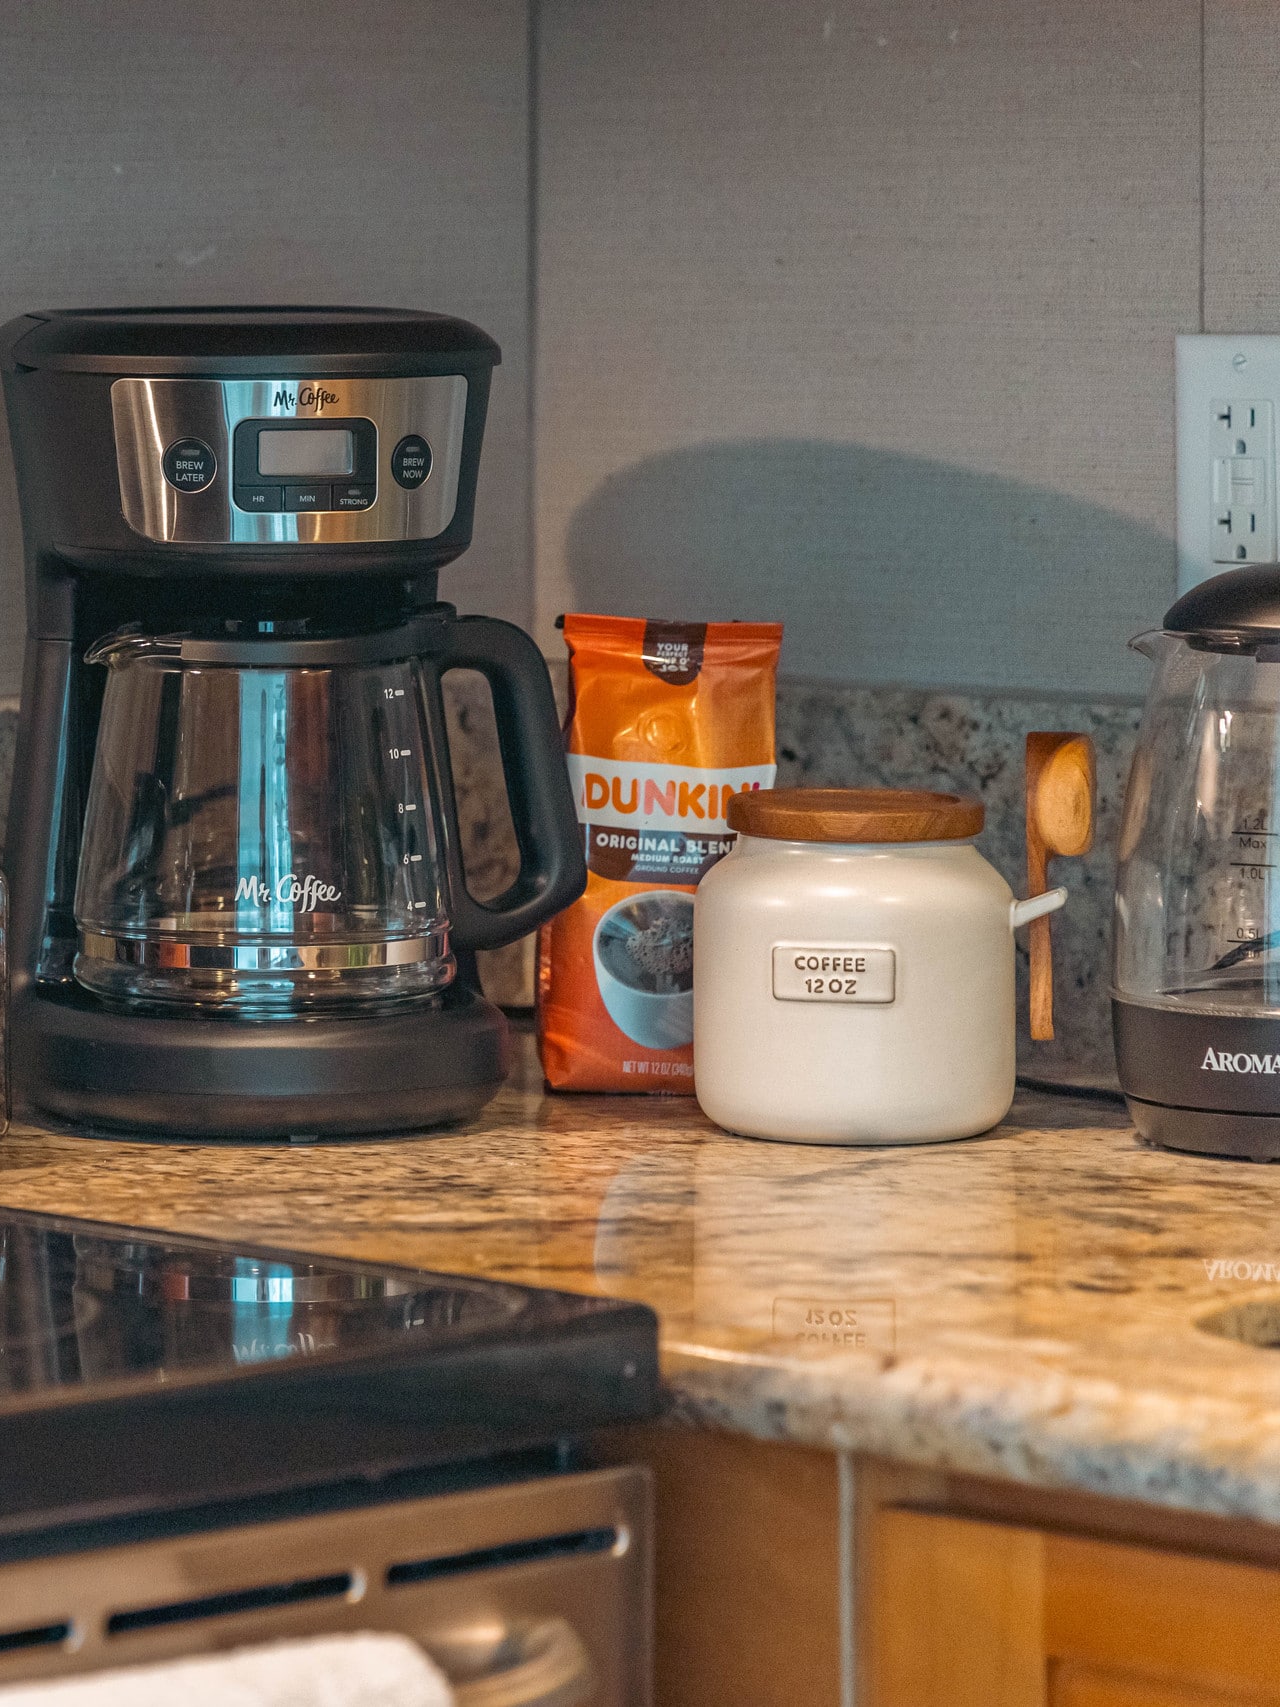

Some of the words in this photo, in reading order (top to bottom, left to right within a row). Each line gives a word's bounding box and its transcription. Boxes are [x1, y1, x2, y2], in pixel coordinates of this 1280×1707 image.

[274, 390, 297, 410] Mr.
[300, 387, 339, 412] Coffee
[176, 461, 204, 470] BREW
[403, 458, 424, 466] BREW
[175, 473, 205, 482] LATER
[403, 470, 423, 479] NOW
[252, 495, 264, 503] HR
[299, 495, 316, 503] MIN
[339, 498, 368, 506] STRONG
[657, 643, 688, 651] YOUR
[384, 689, 394, 699] 12
[389, 748, 399, 759] 10
[398, 803, 404, 814] 8
[596, 833, 680, 853] ORIGINAL
[1239, 837, 1266, 849] Max
[403, 854, 409, 864] 6
[631, 854, 670, 863] MEDIUM
[673, 856, 705, 864] ROAST
[635, 864, 668, 873] GROUND
[669, 866, 699, 874] COFFEE
[1240, 867, 1264, 880] 1.0L
[234, 875, 272, 907] Mr.
[276, 873, 341, 914] Coffee
[407, 901, 413, 911] 4
[795, 956, 866, 972] COFFEE
[805, 979, 824, 994] 12
[828, 979, 857, 995] OZ
[651, 1062, 659, 1074] 12
[660, 1062, 671, 1075] OZ
